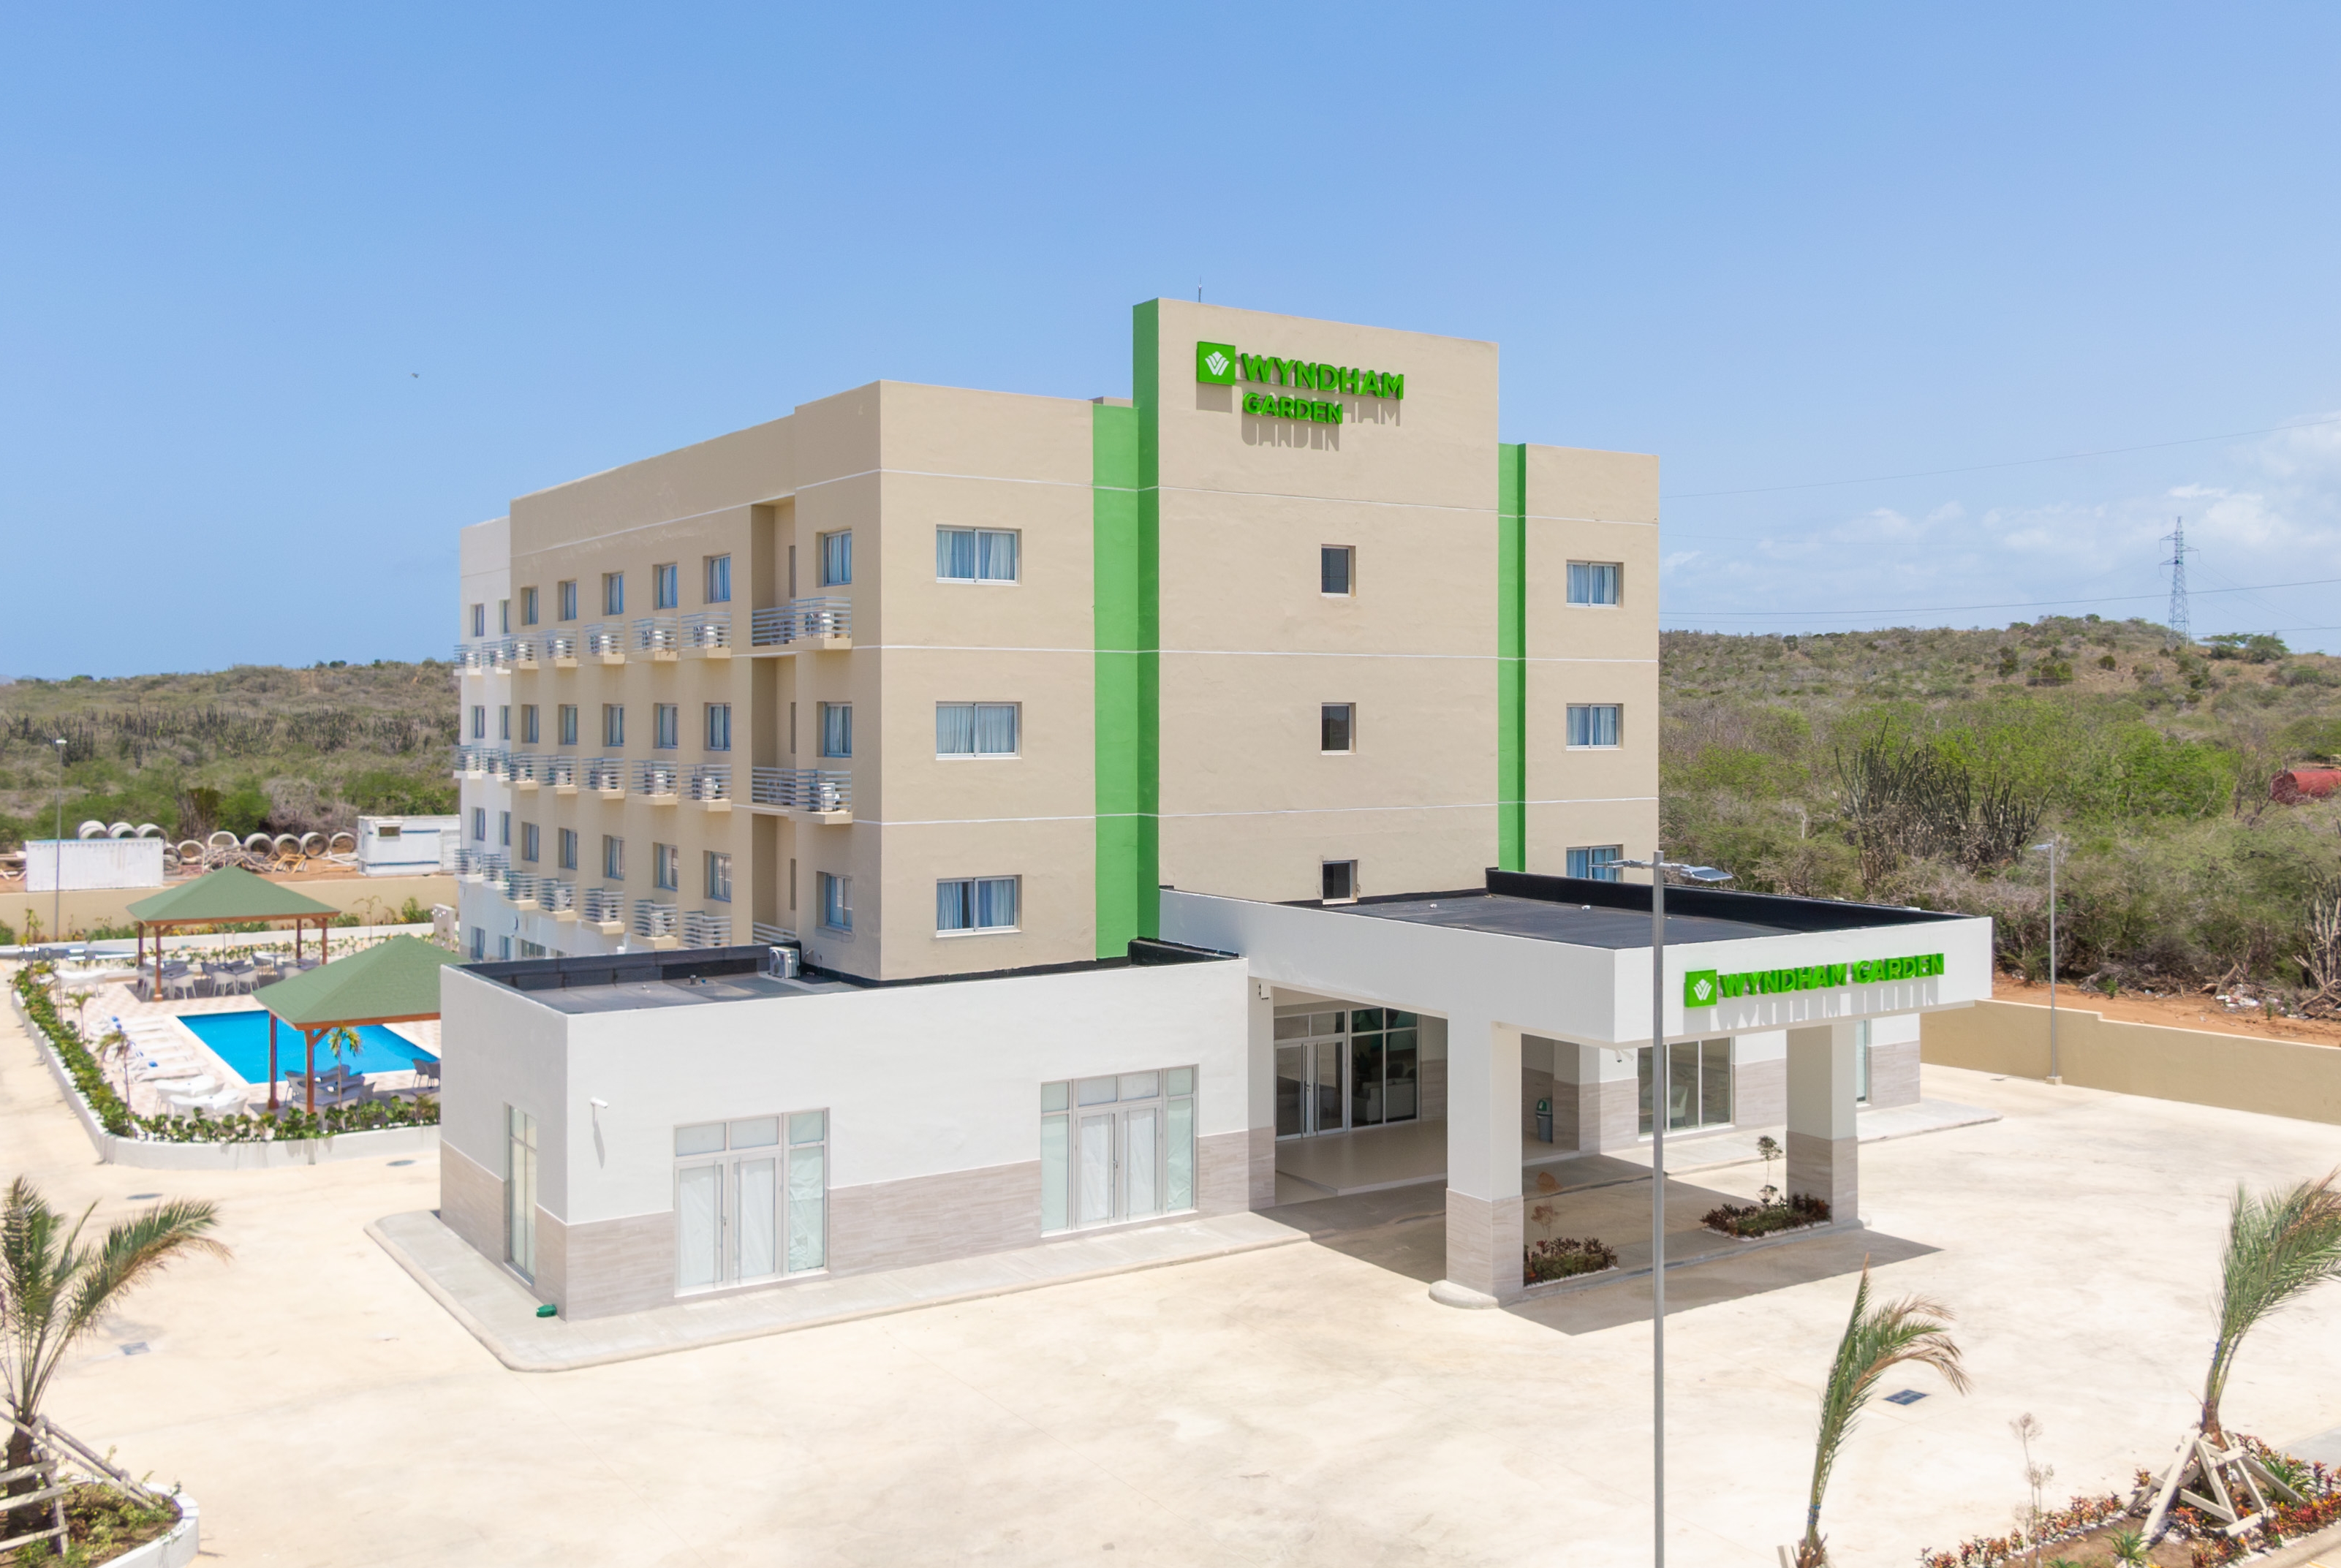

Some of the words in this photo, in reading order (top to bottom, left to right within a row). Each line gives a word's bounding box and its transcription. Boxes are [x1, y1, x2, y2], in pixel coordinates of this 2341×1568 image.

[1241, 352, 1404, 400] WYNDHAM
[1242, 392, 1342, 424] GARDEN
[1720, 963, 1847, 998] WYNDHAM
[1852, 952, 1944, 984] GARDEN
